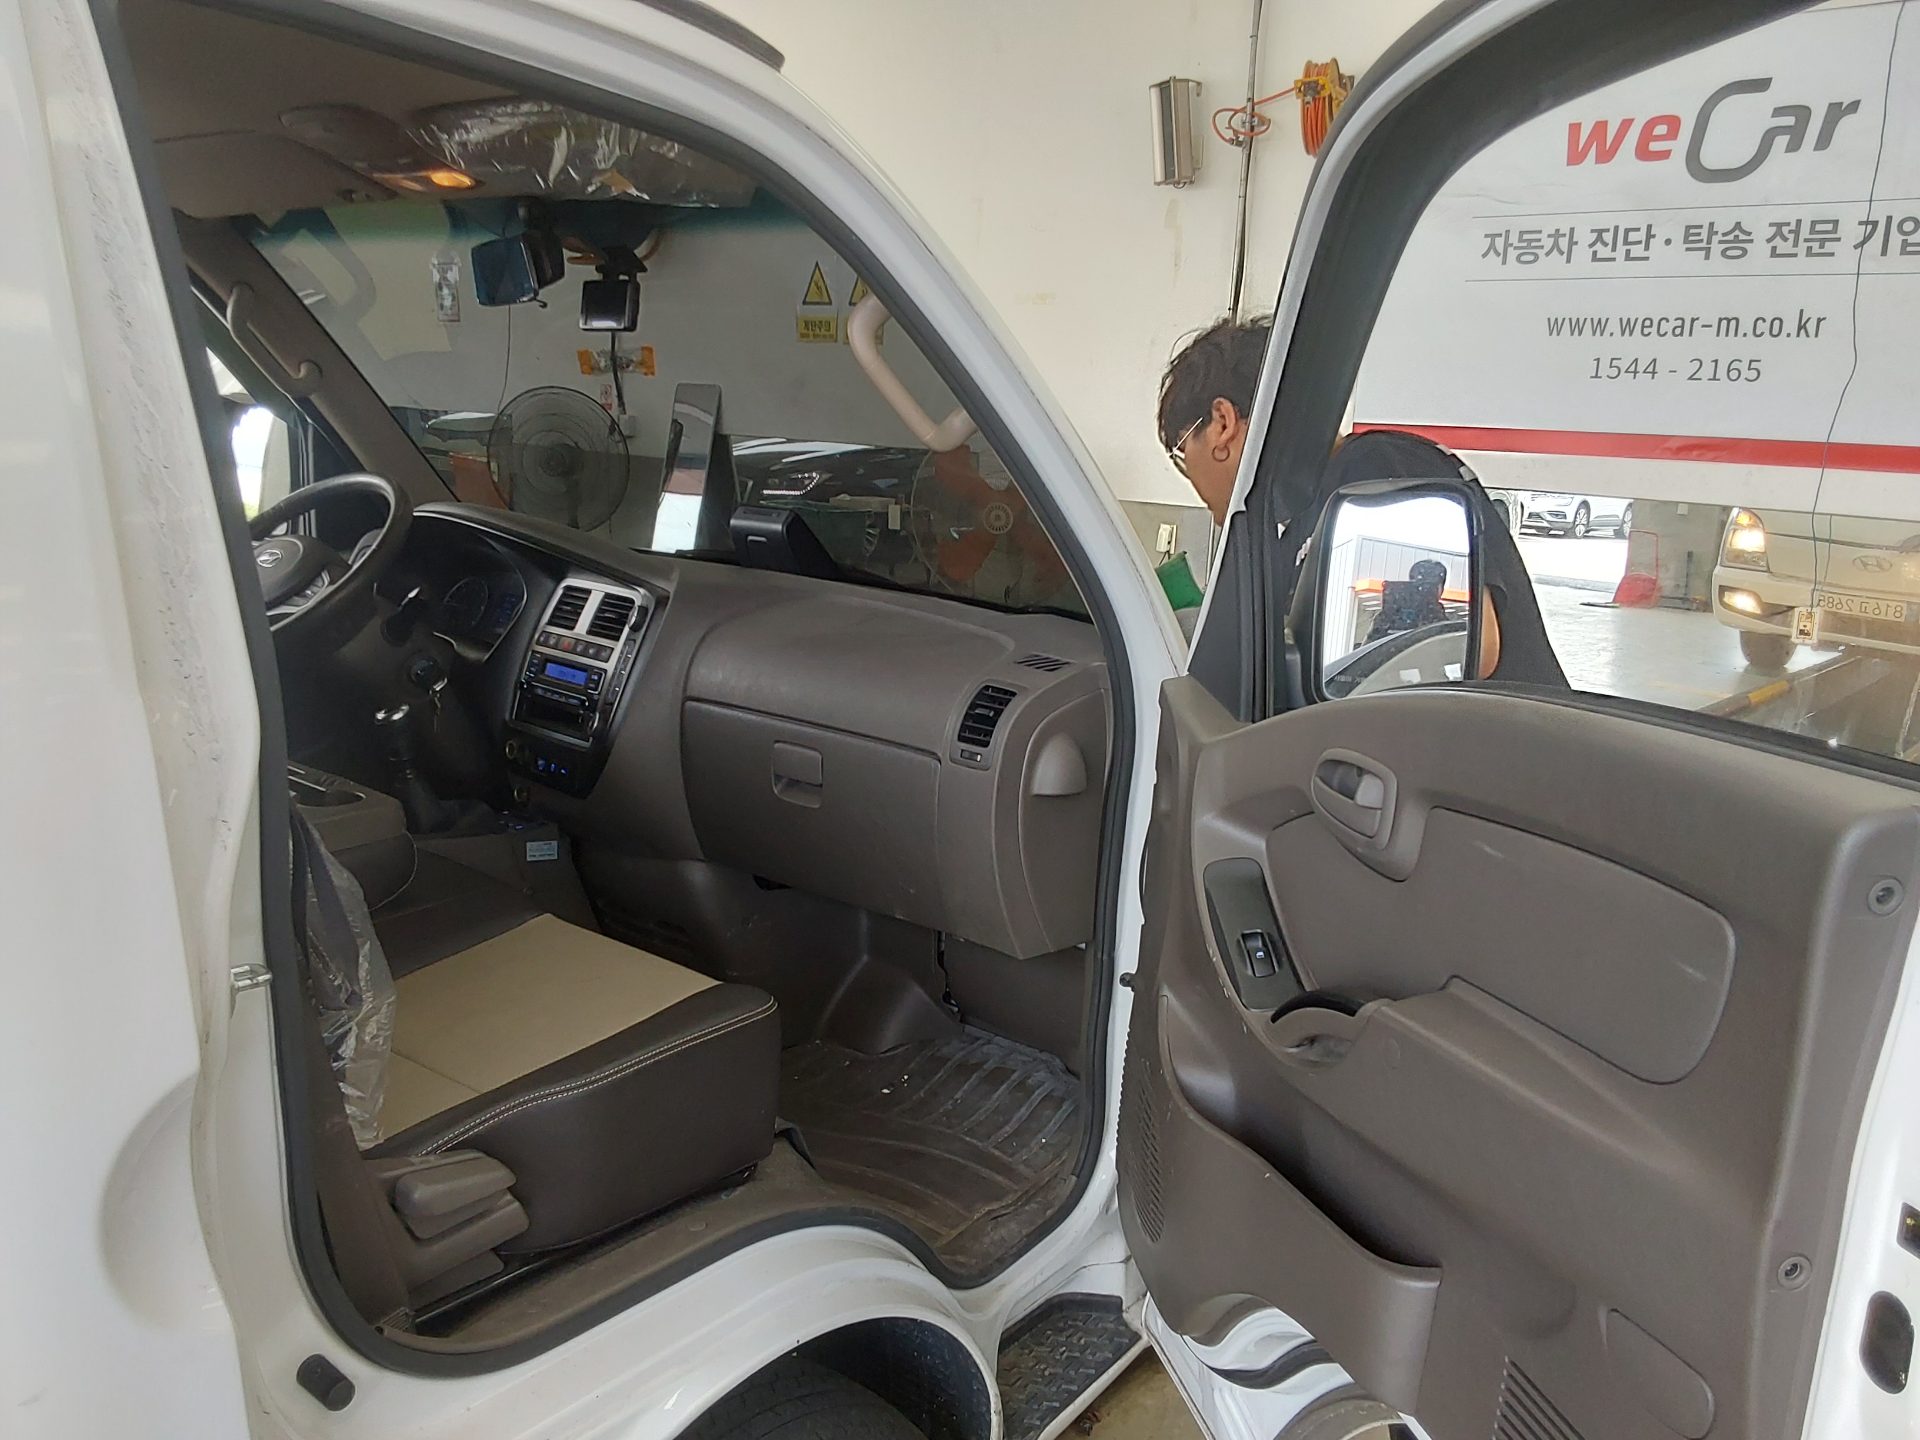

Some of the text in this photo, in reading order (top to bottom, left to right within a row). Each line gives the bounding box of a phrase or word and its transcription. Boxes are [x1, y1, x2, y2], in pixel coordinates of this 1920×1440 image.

[1566, 77, 1861, 184] weCar
[1482, 227, 1578, 265] 자동차
[1766, 218, 1841, 257] 전문
[1547, 309, 1827, 339] www.wecar-m.co.kr
[1591, 357, 1659, 381] 1544
[1687, 359, 1762, 382] 2165
